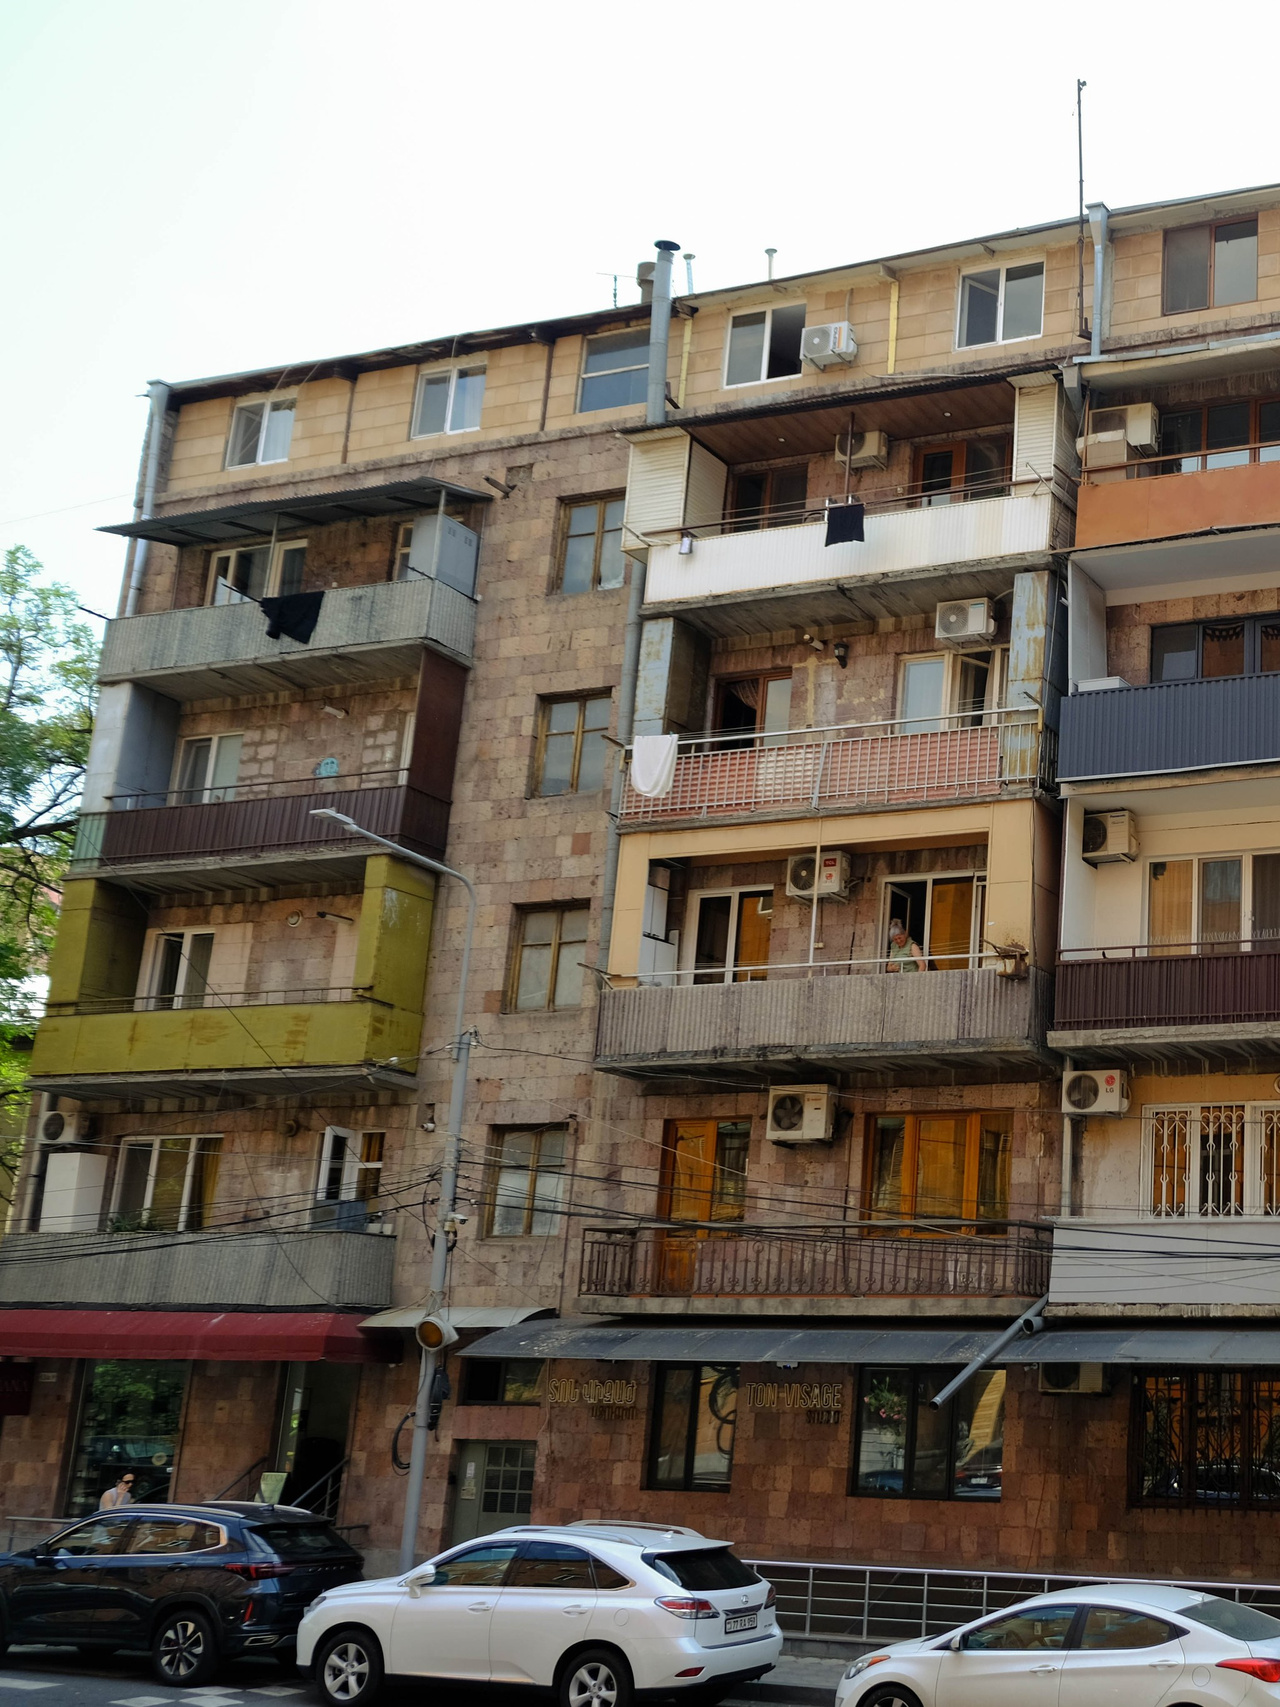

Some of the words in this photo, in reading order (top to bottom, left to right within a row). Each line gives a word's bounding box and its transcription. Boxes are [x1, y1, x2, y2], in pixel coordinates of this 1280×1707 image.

[745, 1382, 778, 1407] TON
[784, 1383, 843, 1409] VISAGE
[806, 1410, 840, 1424] STUDIO
